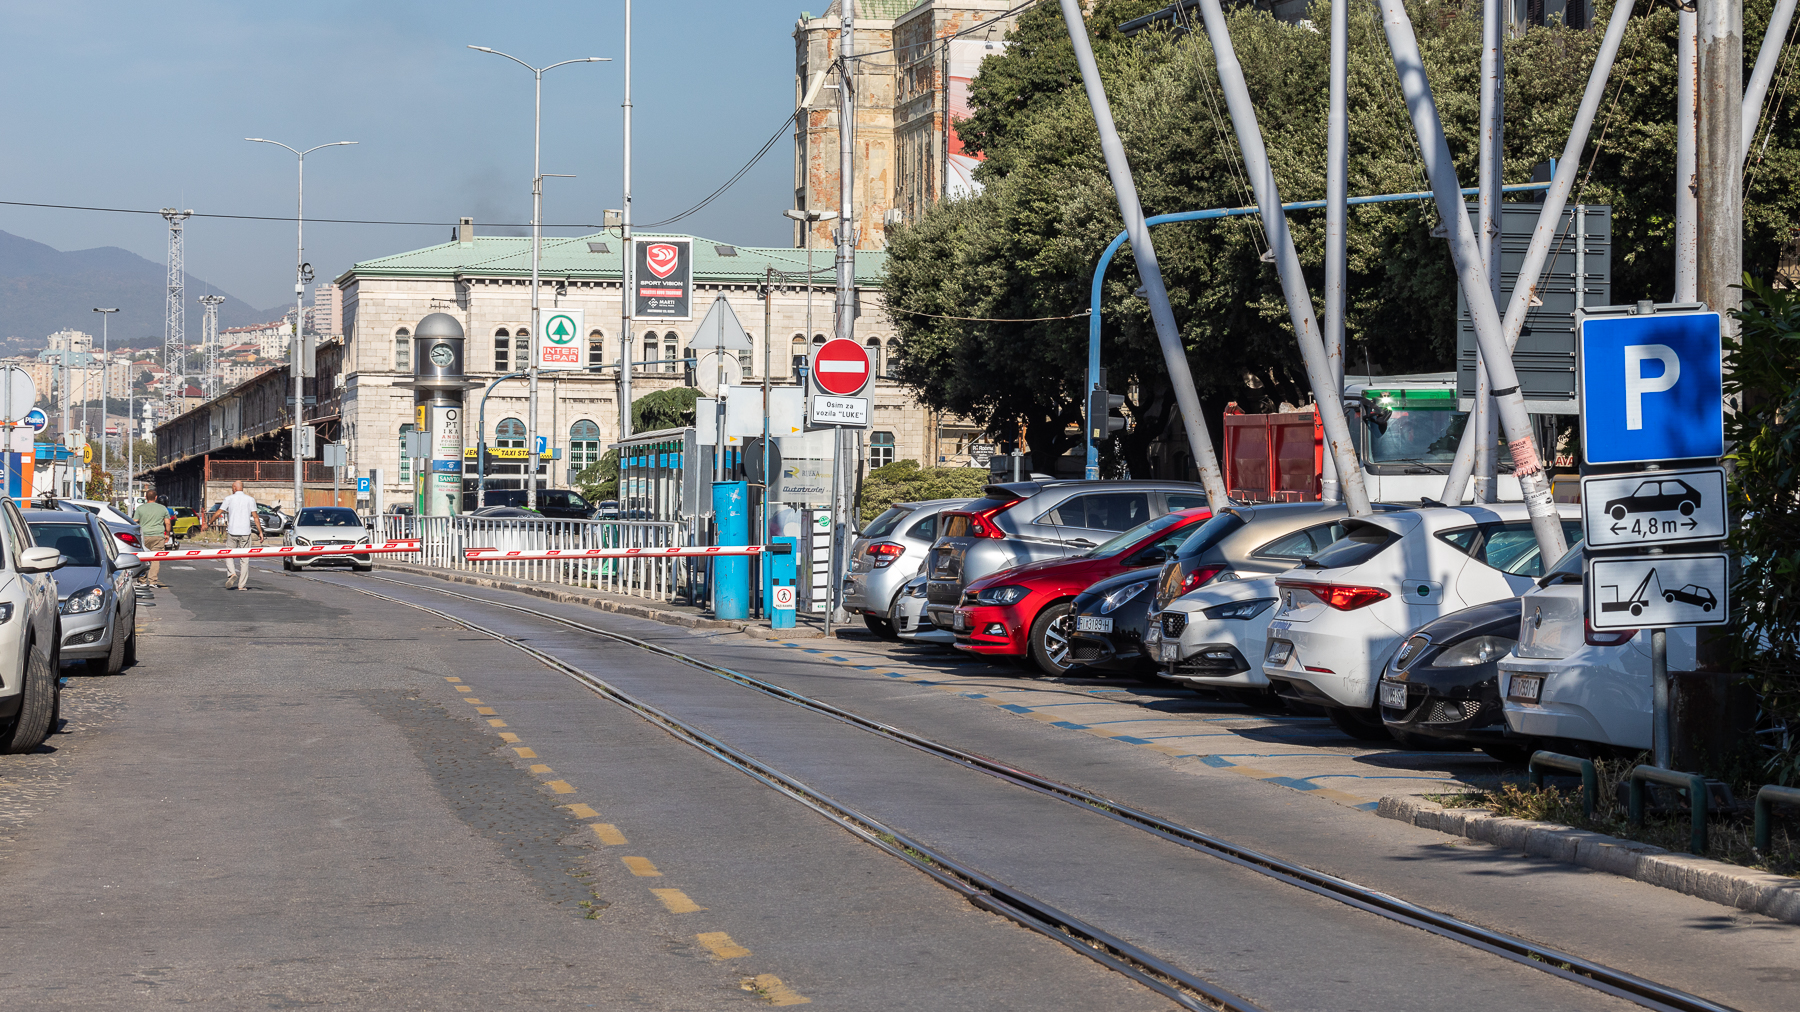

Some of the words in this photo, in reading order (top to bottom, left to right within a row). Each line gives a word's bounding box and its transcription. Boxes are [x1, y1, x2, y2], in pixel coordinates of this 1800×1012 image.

[544, 347, 578, 355] INTER
[544, 354, 577, 362] SPAR
[1625, 344, 1680, 430] P
[826, 401, 844, 409] Osim
[25, 416, 44, 424] Planet
[361, 480, 368, 489] P
